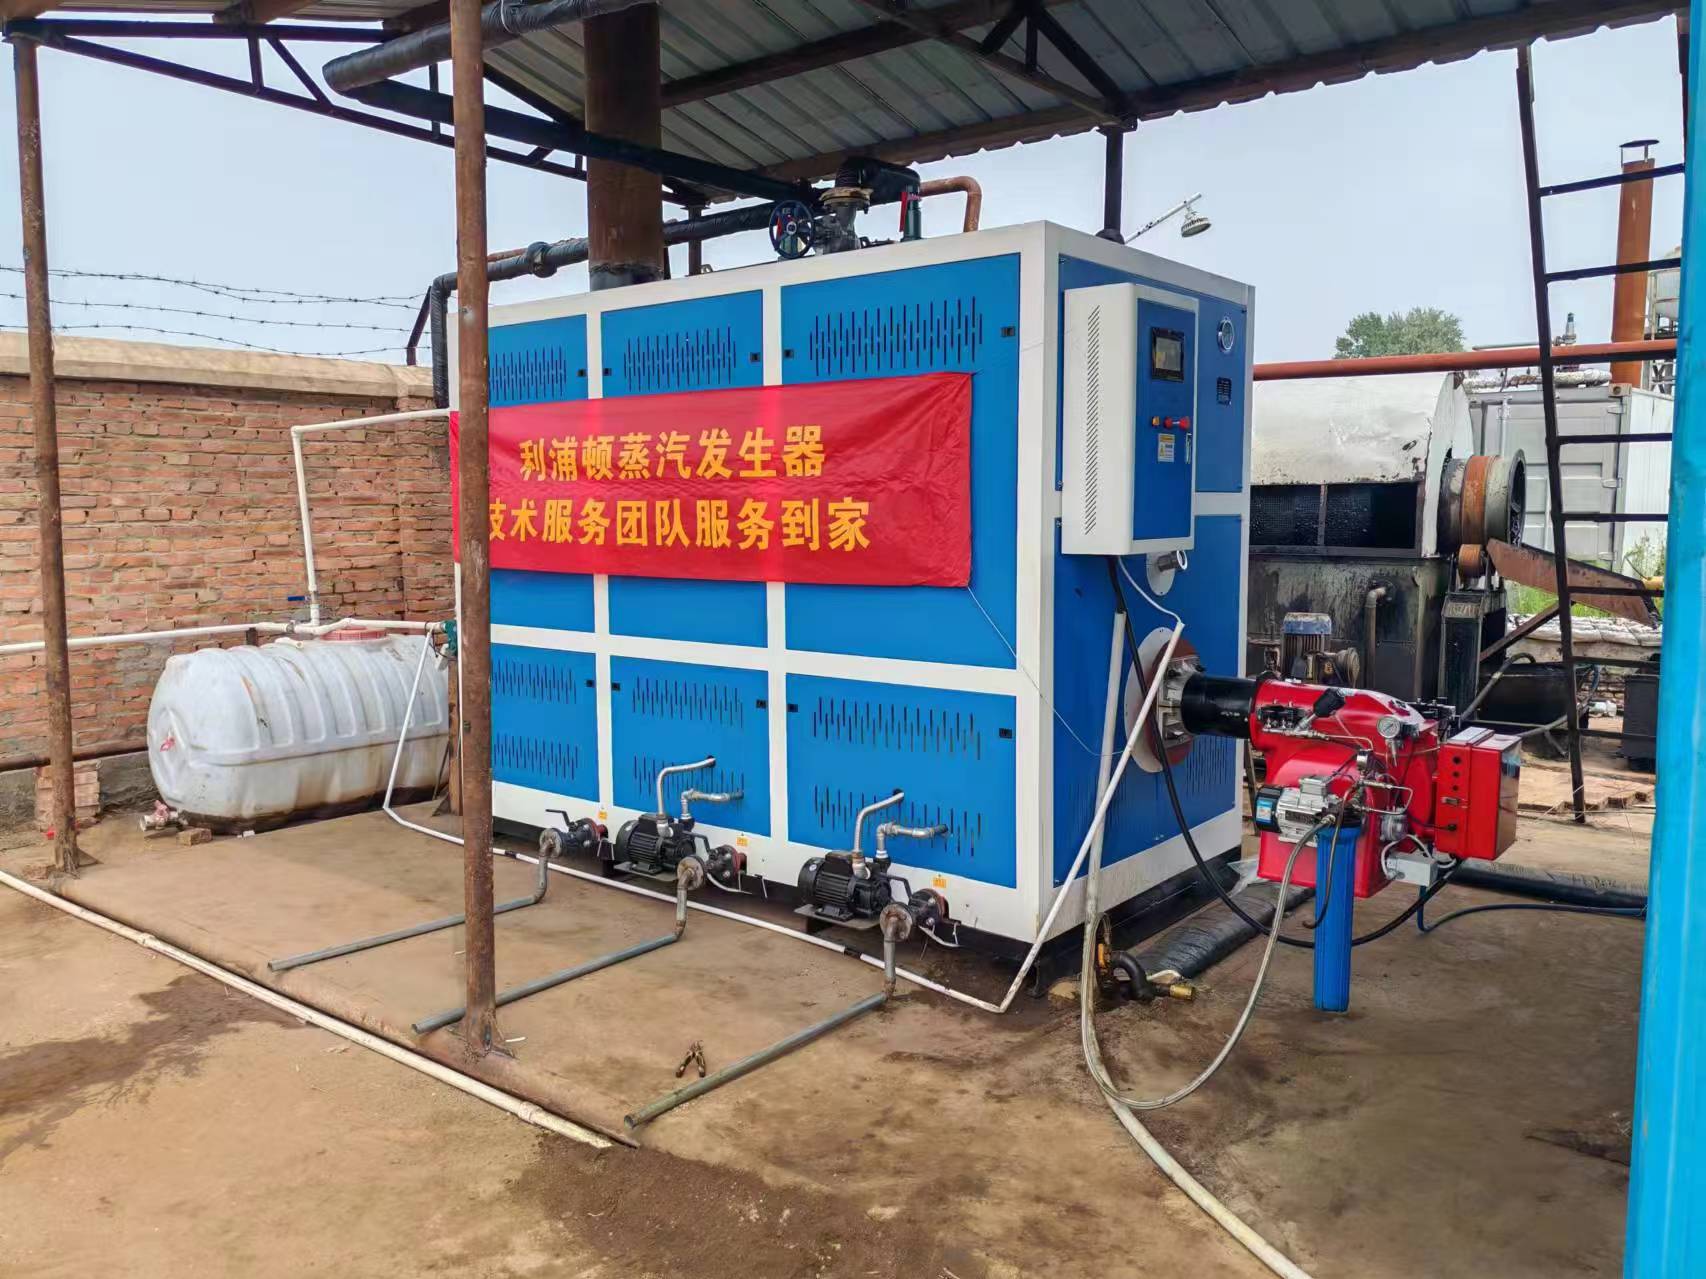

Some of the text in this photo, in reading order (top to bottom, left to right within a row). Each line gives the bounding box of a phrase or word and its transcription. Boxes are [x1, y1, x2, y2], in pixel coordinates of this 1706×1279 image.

[519, 425, 825, 481] 利浦顿蒸汽发生器
